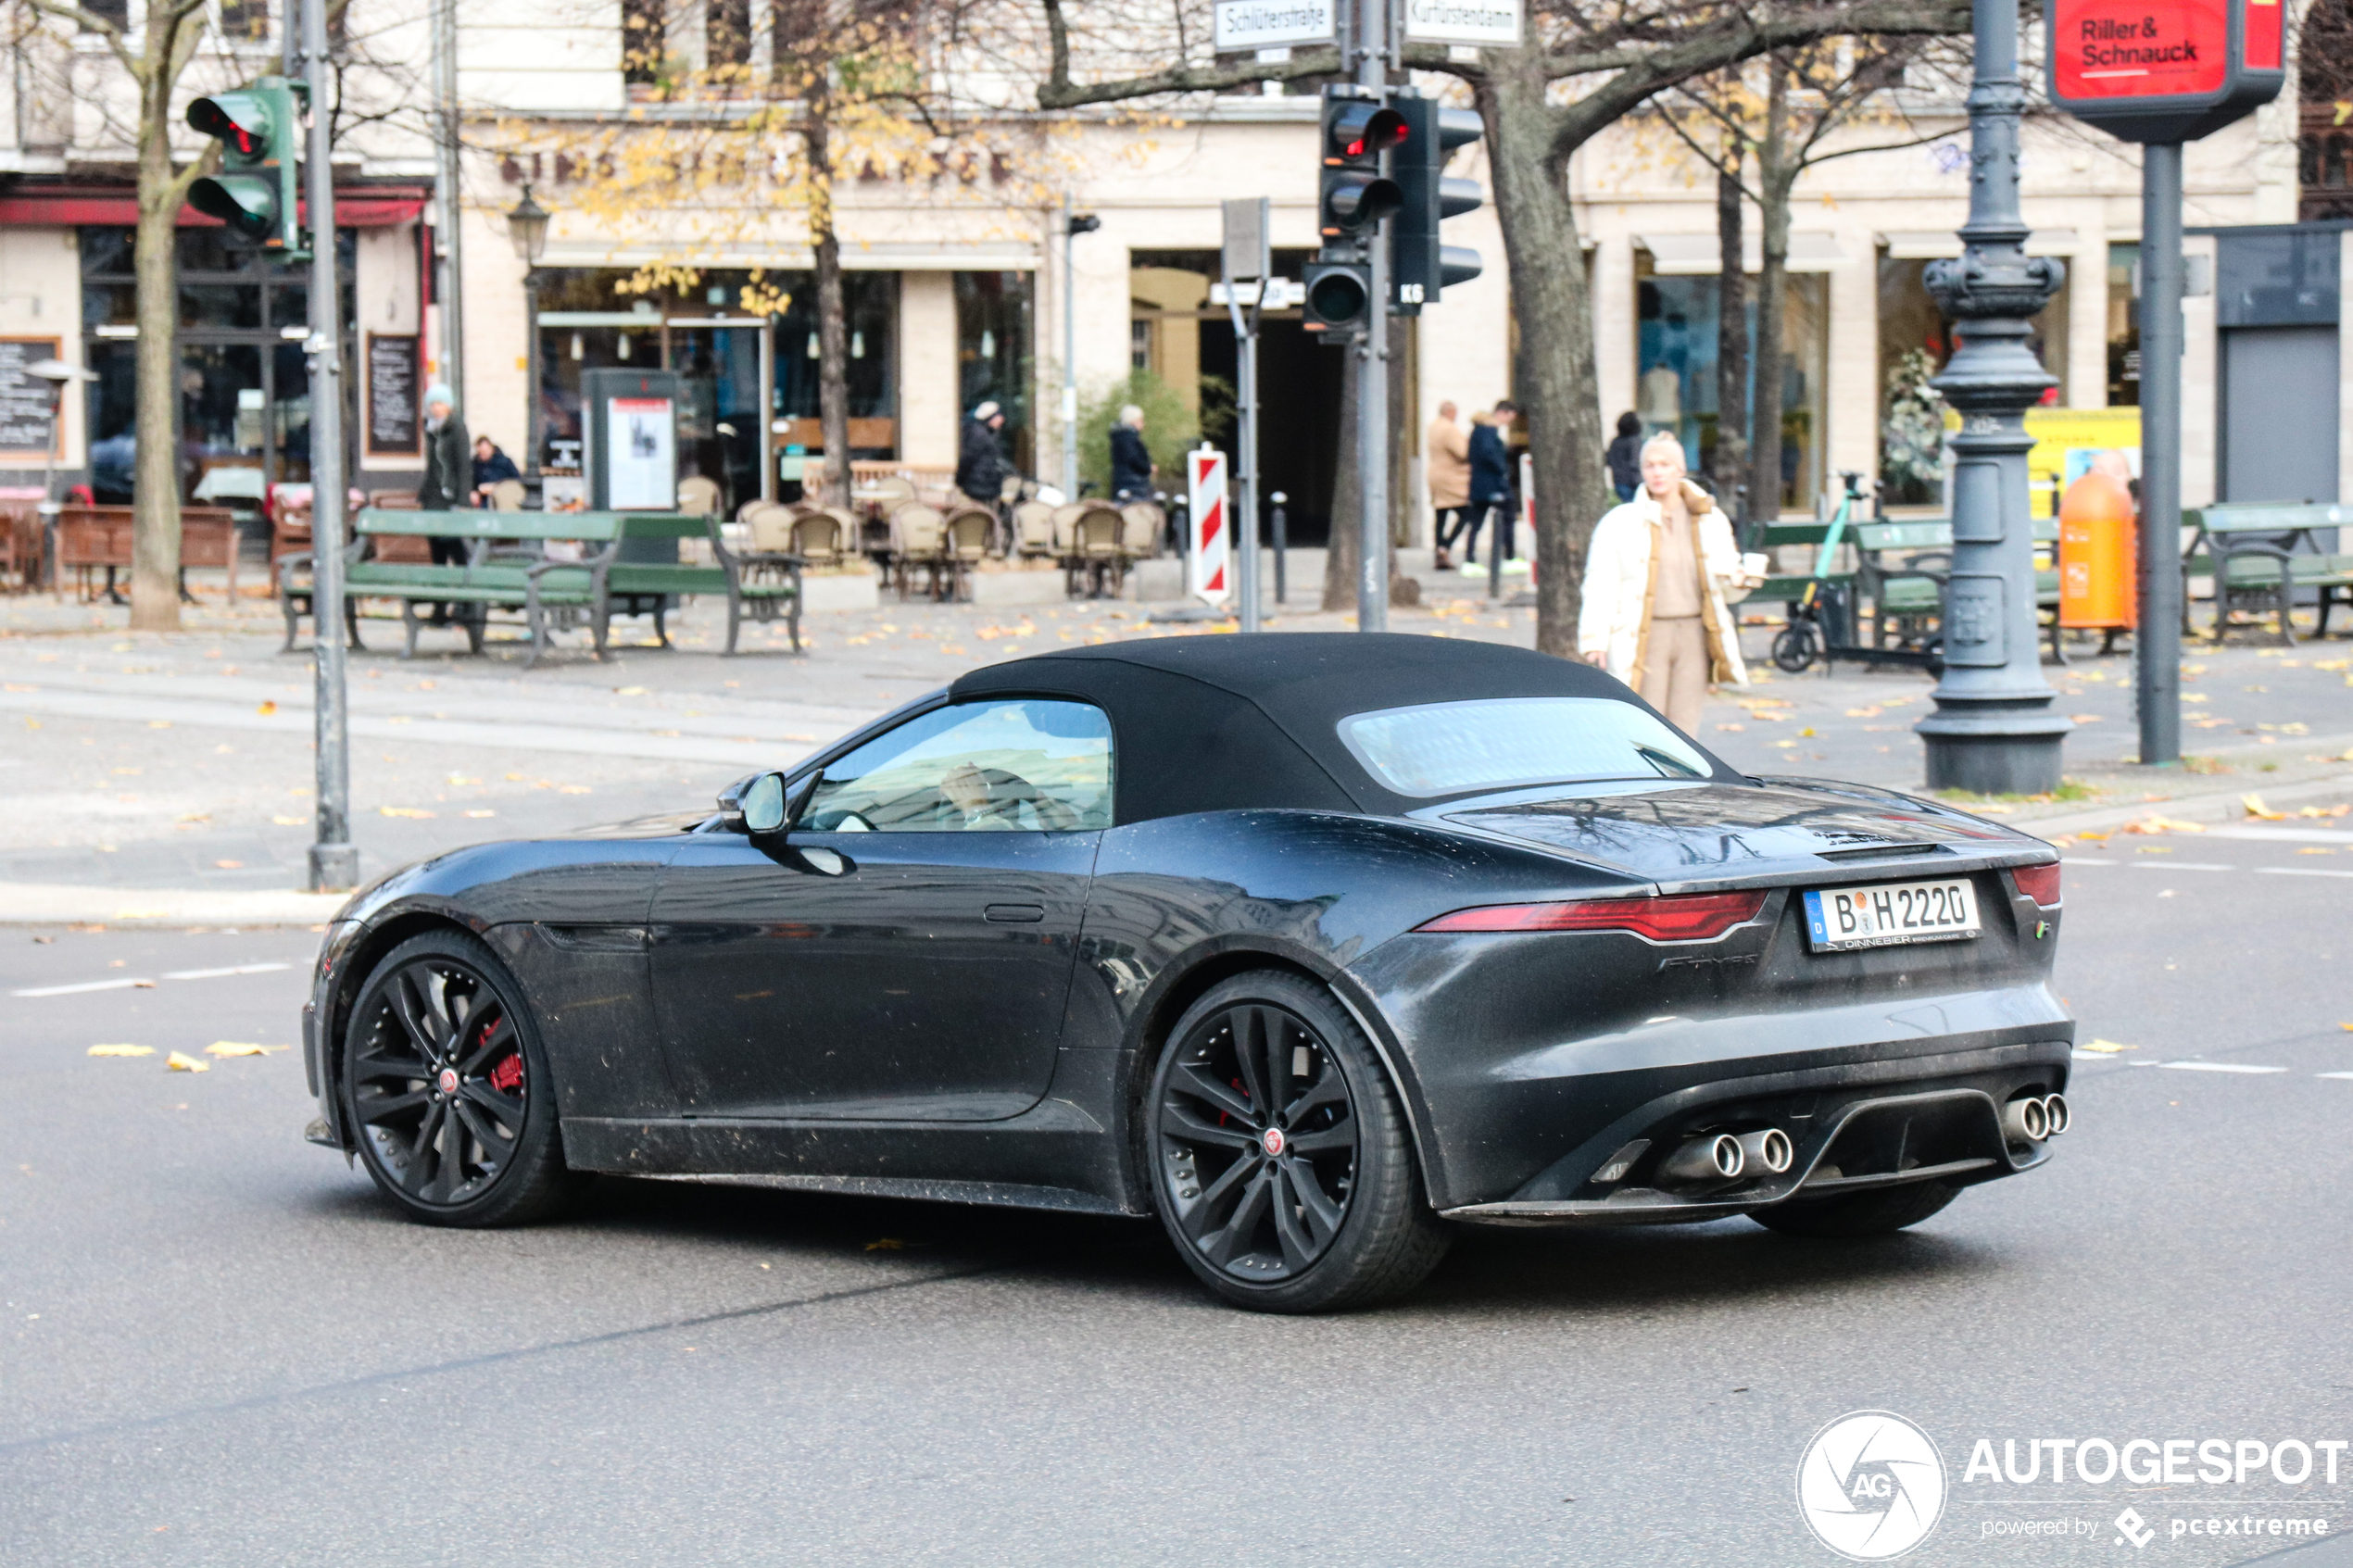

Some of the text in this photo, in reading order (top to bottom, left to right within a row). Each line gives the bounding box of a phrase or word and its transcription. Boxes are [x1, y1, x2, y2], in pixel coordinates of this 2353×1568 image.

[1226, 2, 1325, 33] Schlüterstraße
[1408, 0, 1514, 28] Kurfürstendamm
[2081, 16, 2158, 41] Riller &
[2081, 40, 2198, 67] Schnauck
[1400, 283, 1425, 304] K6
[1813, 922, 1823, 935] D
[1843, 935, 1912, 949] DINNEBIER
